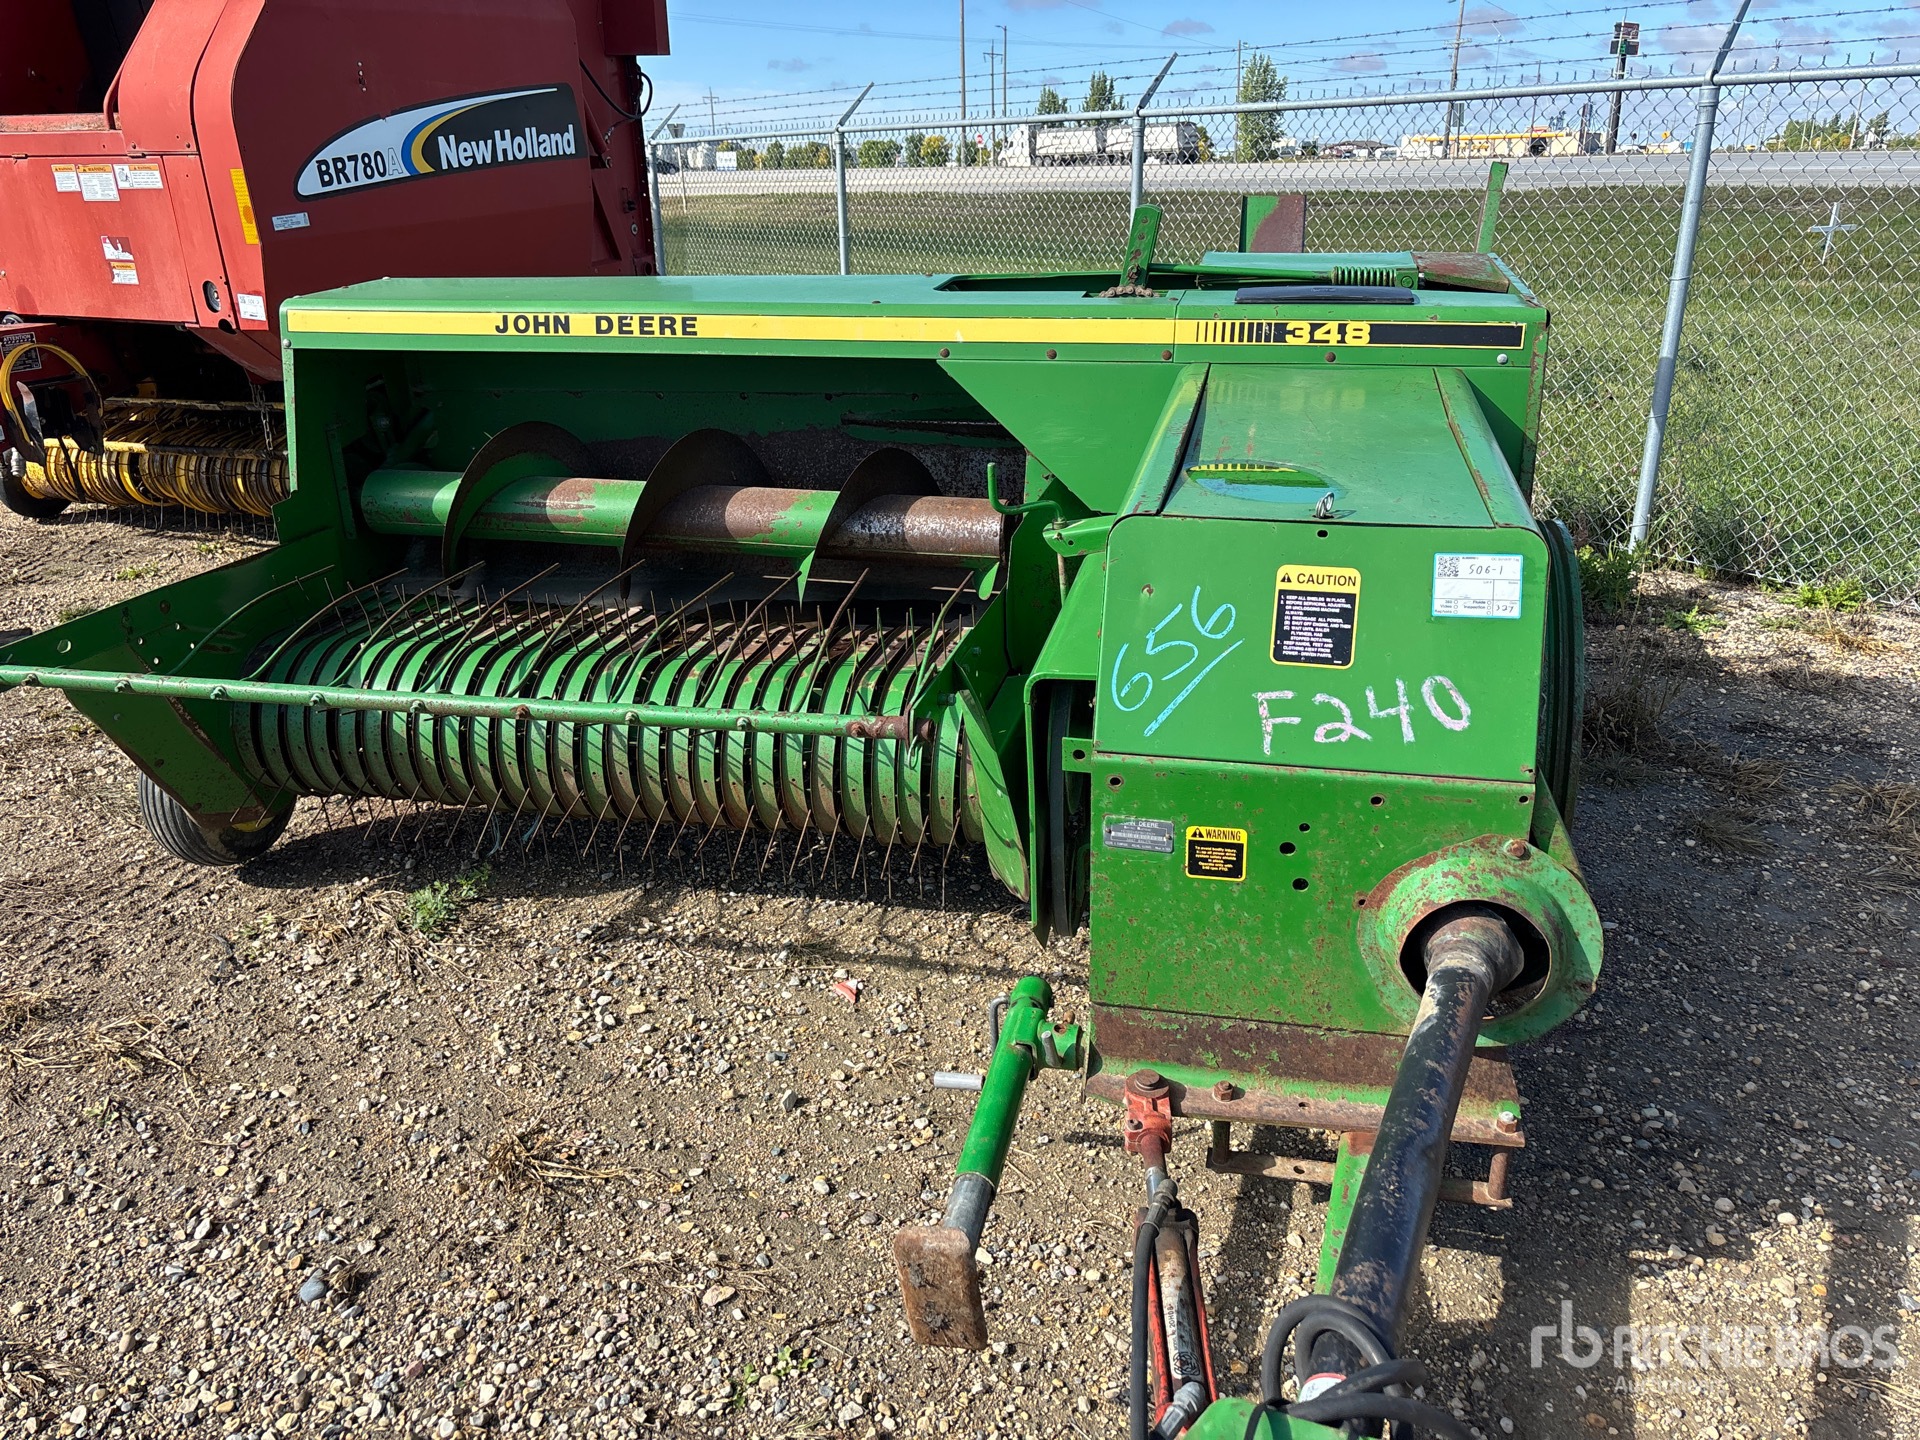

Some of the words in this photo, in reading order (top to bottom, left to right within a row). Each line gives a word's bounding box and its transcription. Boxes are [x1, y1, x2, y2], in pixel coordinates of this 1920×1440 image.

[315, 147, 403, 187] BR780A
[437, 134, 493, 170] New
[494, 124, 576, 162] Holland
[495, 315, 570, 334] JOHN
[595, 315, 698, 336] DEERE
[1285, 321, 1371, 344] 348
[1297, 573, 1356, 586] CAUTION
[1111, 585, 1237, 711] 656
[1252, 675, 1471, 755] F240
[1205, 828, 1241, 841] WARNING
